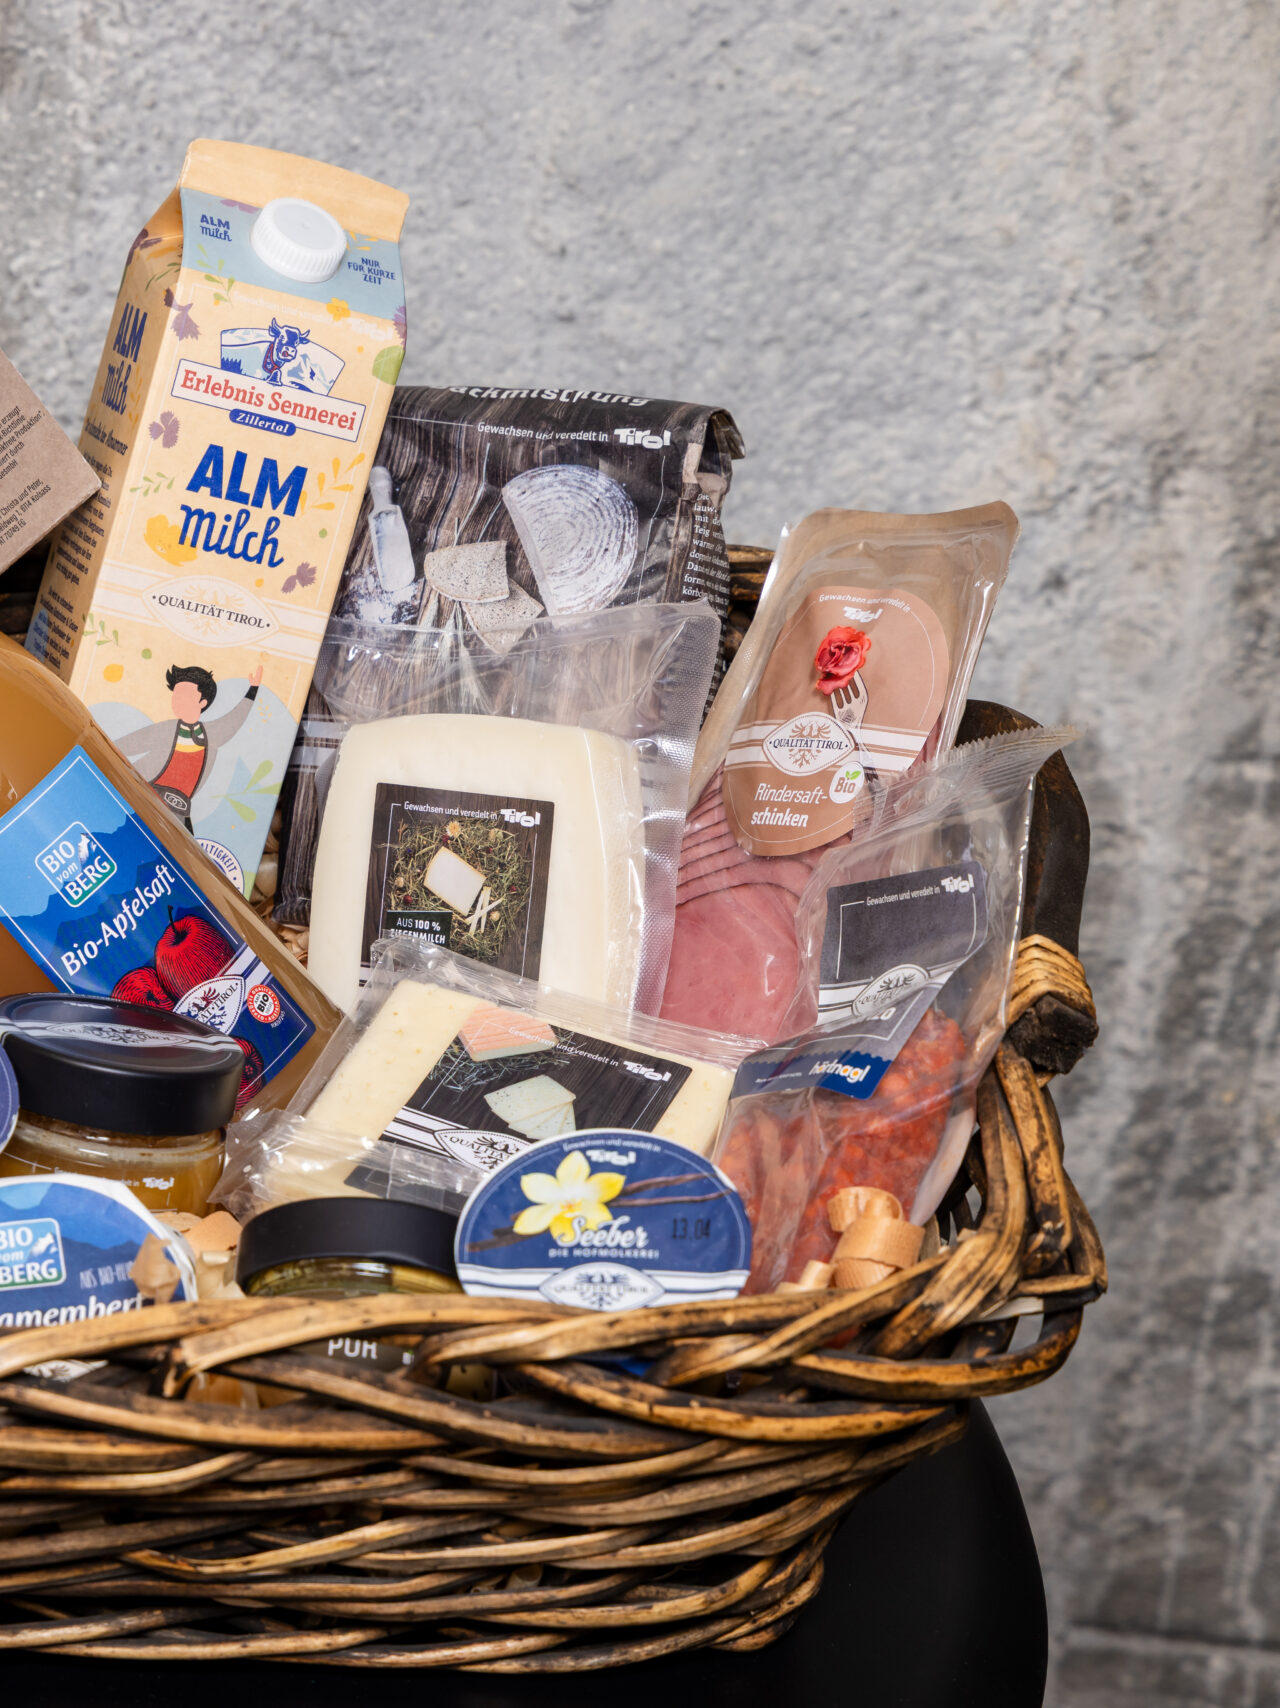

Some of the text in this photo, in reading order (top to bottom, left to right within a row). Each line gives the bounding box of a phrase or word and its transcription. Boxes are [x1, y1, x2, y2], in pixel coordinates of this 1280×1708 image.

[200, 214, 230, 230] ALM
[200, 225, 232, 242] milch
[347, 262, 396, 281] FÜR KURZE
[361, 257, 380, 269] NUR
[363, 273, 382, 285] ZEIT
[112, 302, 148, 363] ALM
[101, 360, 132, 415] milch
[180, 368, 357, 433] Erlebnis Sennerei
[1, 406, 21, 425] erzeugt
[235, 412, 291, 435] Zillertal
[477, 421, 671, 449] Gewachsen und veredelt in Tirol
[9, 441, 25, 457] durch
[185, 443, 308, 517] ALM
[694, 525, 710, 537] Teig
[695, 515, 709, 523] mit
[178, 504, 285, 568] milch
[157, 593, 266, 629] QUALITÄT TIROL
[772, 736, 846, 751] QUALITÄT TIROL
[754, 782, 828, 806] Rindersaft-
[834, 775, 856, 794] Bio
[404, 801, 541, 828] Gewachsen und veredelt in Tirol
[750, 806, 809, 828] schinken
[42, 839, 77, 875] BIO
[55, 861, 79, 885] vom
[64, 855, 112, 902] BERG
[866, 874, 975, 906] Gewachsen und veredelt in Tirol
[59, 863, 177, 977] Bio-Apfelsaft
[396, 917, 441, 931] AUS 100 %
[215, 985, 238, 1010] TIROL
[257, 993, 270, 1013] BIO
[508, 1026, 672, 1083] Gewachsen und veredelt in Tirol
[808, 1059, 871, 1084] hörtnagl
[585, 1149, 637, 1166] Tirol
[142, 1176, 175, 1190] Tirol
[555, 1215, 649, 1248] Seeber
[672, 1217, 712, 1241] 13.04
[548, 1248, 660, 1260] DIE HOFMOLKEREI
